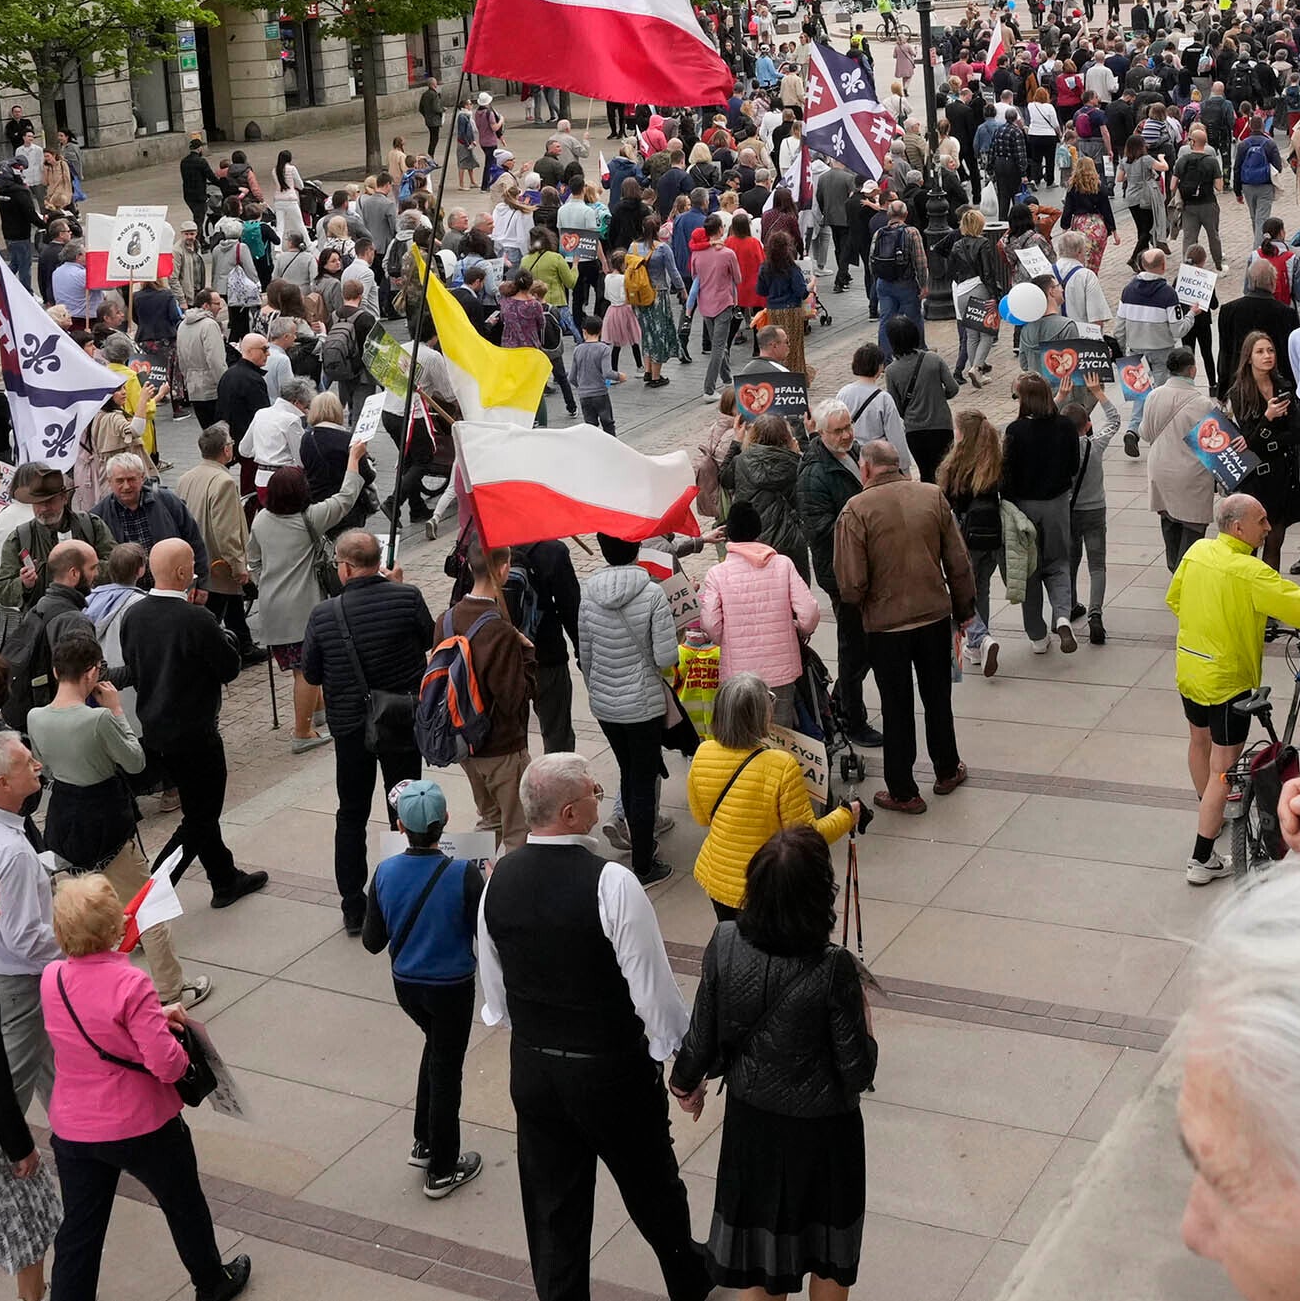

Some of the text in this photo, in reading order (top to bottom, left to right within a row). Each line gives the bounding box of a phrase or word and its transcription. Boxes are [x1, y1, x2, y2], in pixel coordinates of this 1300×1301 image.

[117, 222, 156, 241] RADIO MARYJA
[1180, 276, 1202, 285] NIECH
[1078, 359, 1110, 369] ŻYCIA
[774, 395, 806, 405] ŻYCIA
[1218, 452, 1242, 481] ŻYCIA
[668, 588, 689, 604] YJE
[791, 741, 822, 766] ŻYJE
